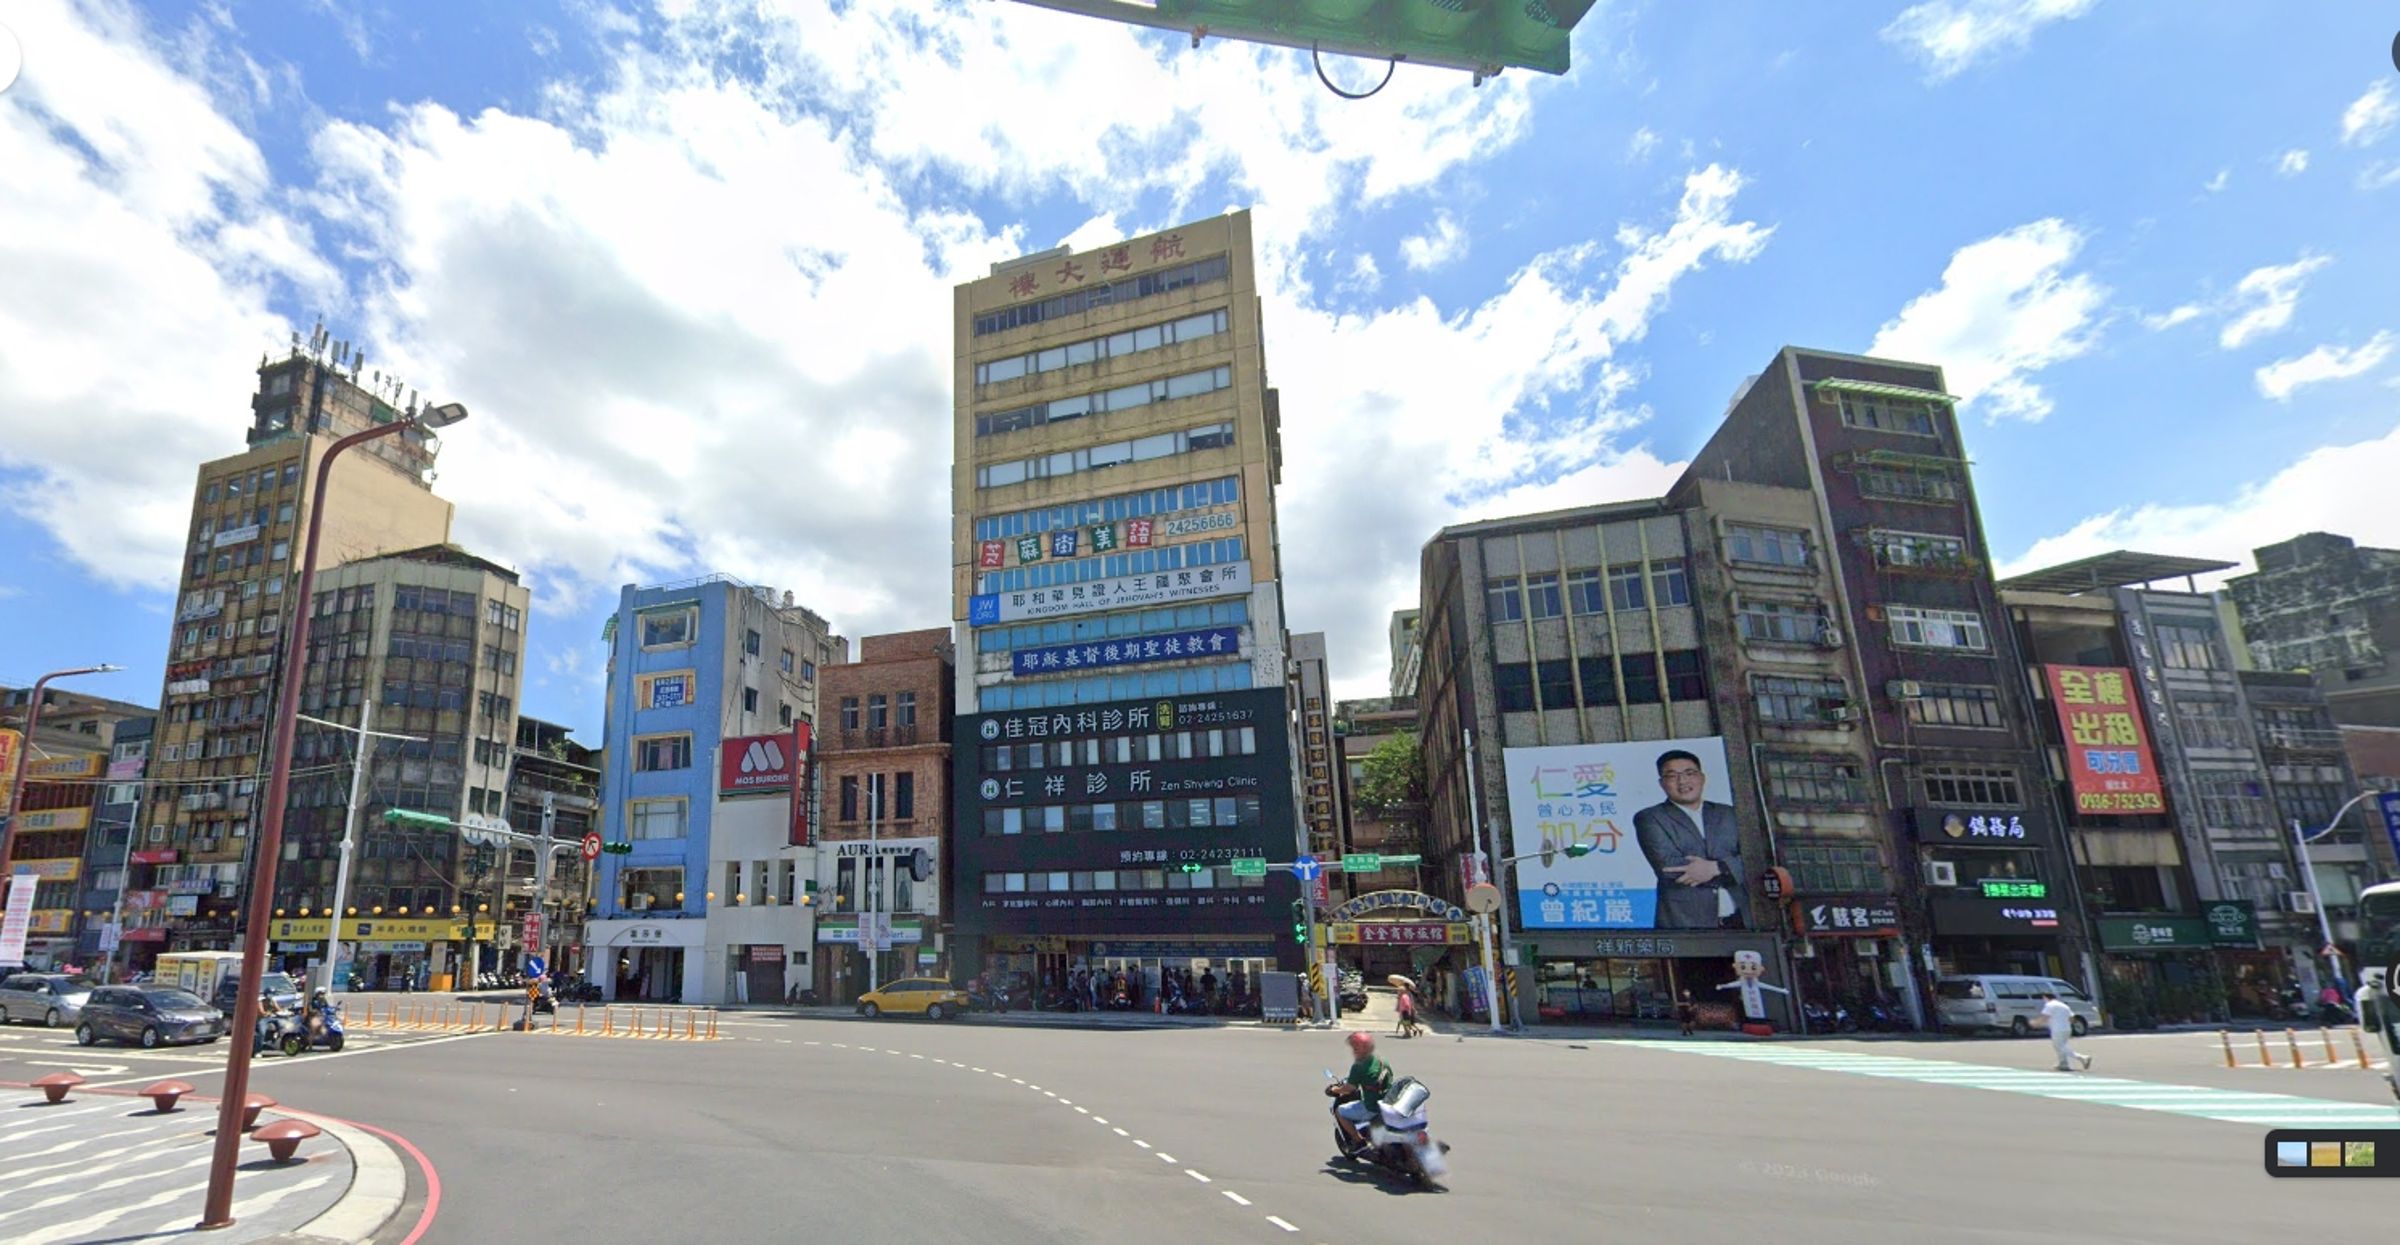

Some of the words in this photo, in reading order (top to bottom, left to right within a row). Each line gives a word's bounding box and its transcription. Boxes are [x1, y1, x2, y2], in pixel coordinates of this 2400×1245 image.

[978, 599, 994, 610] JW
[1027, 604, 1069, 615] KINGDOM
[1073, 601, 1094, 609] HALL
[1098, 598, 1111, 606] OF
[1170, 583, 1220, 598] WITNESSES
[2071, 711, 2139, 746] 出租
[735, 777, 755, 785] MOS
[756, 774, 790, 784] BURGER
[1005, 769, 1152, 797] 仁祥診所
[1161, 780, 1179, 791] Zen
[1184, 778, 1223, 791] Shyang
[1228, 776, 1257, 787] Clinic
[1531, 762, 1617, 799] 仁愛
[837, 844, 880, 856] AURA
[1537, 819, 1623, 856] 加分
